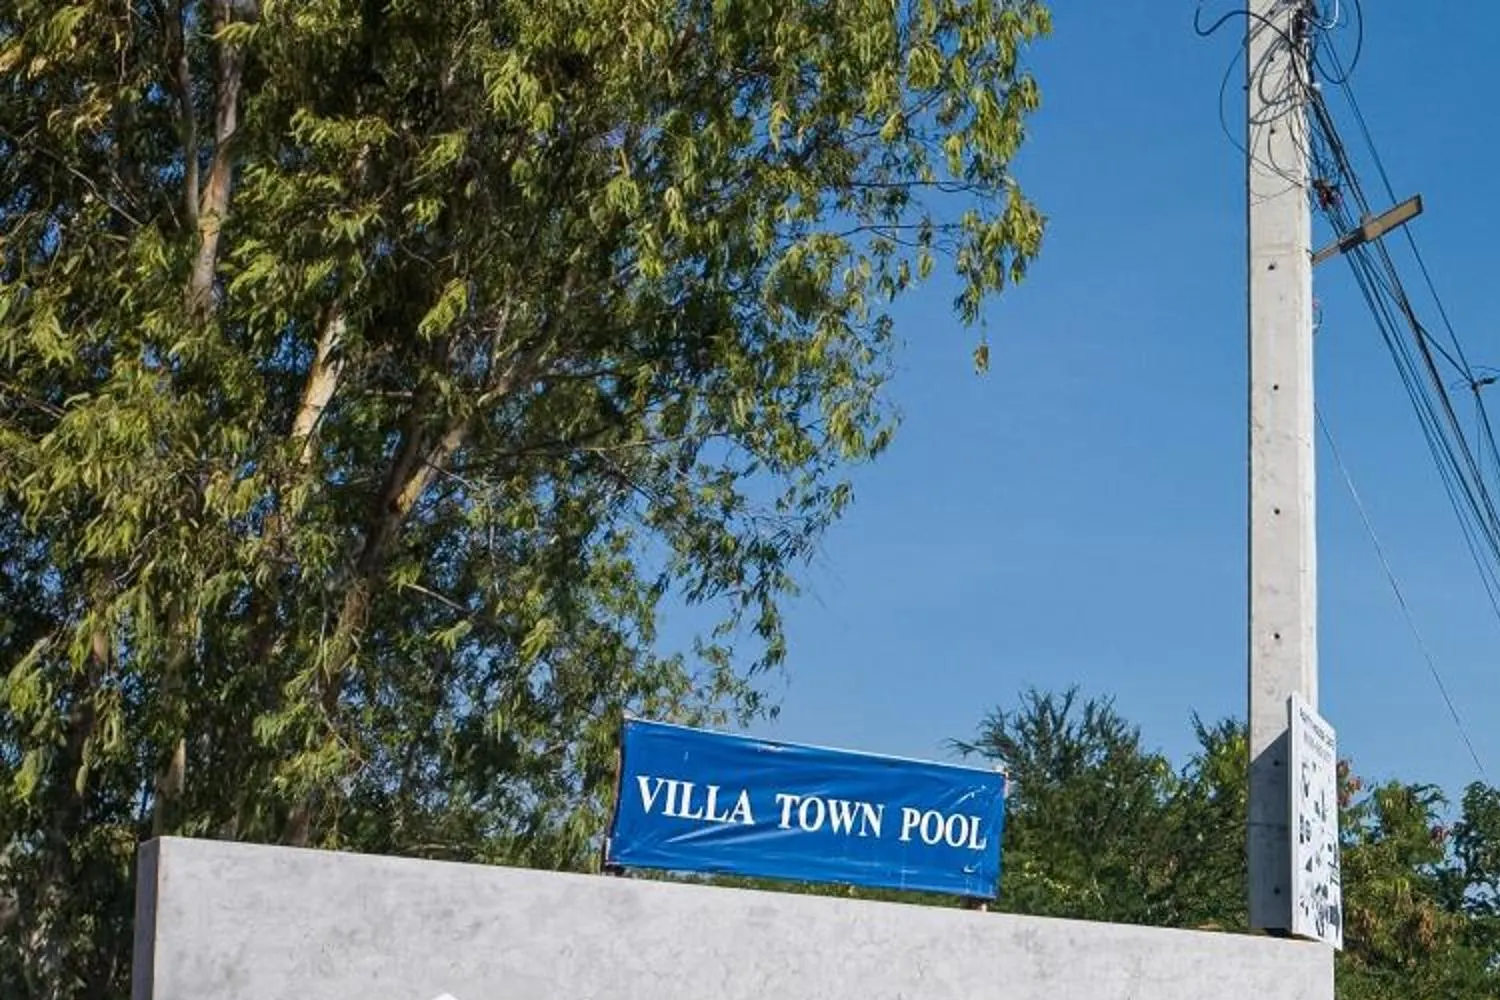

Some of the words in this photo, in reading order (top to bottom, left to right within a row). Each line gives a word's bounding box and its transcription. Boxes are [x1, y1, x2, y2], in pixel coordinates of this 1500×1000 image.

[637, 776, 754, 825] VILLA
[776, 794, 885, 838] TOWN
[900, 808, 986, 850] POOL
